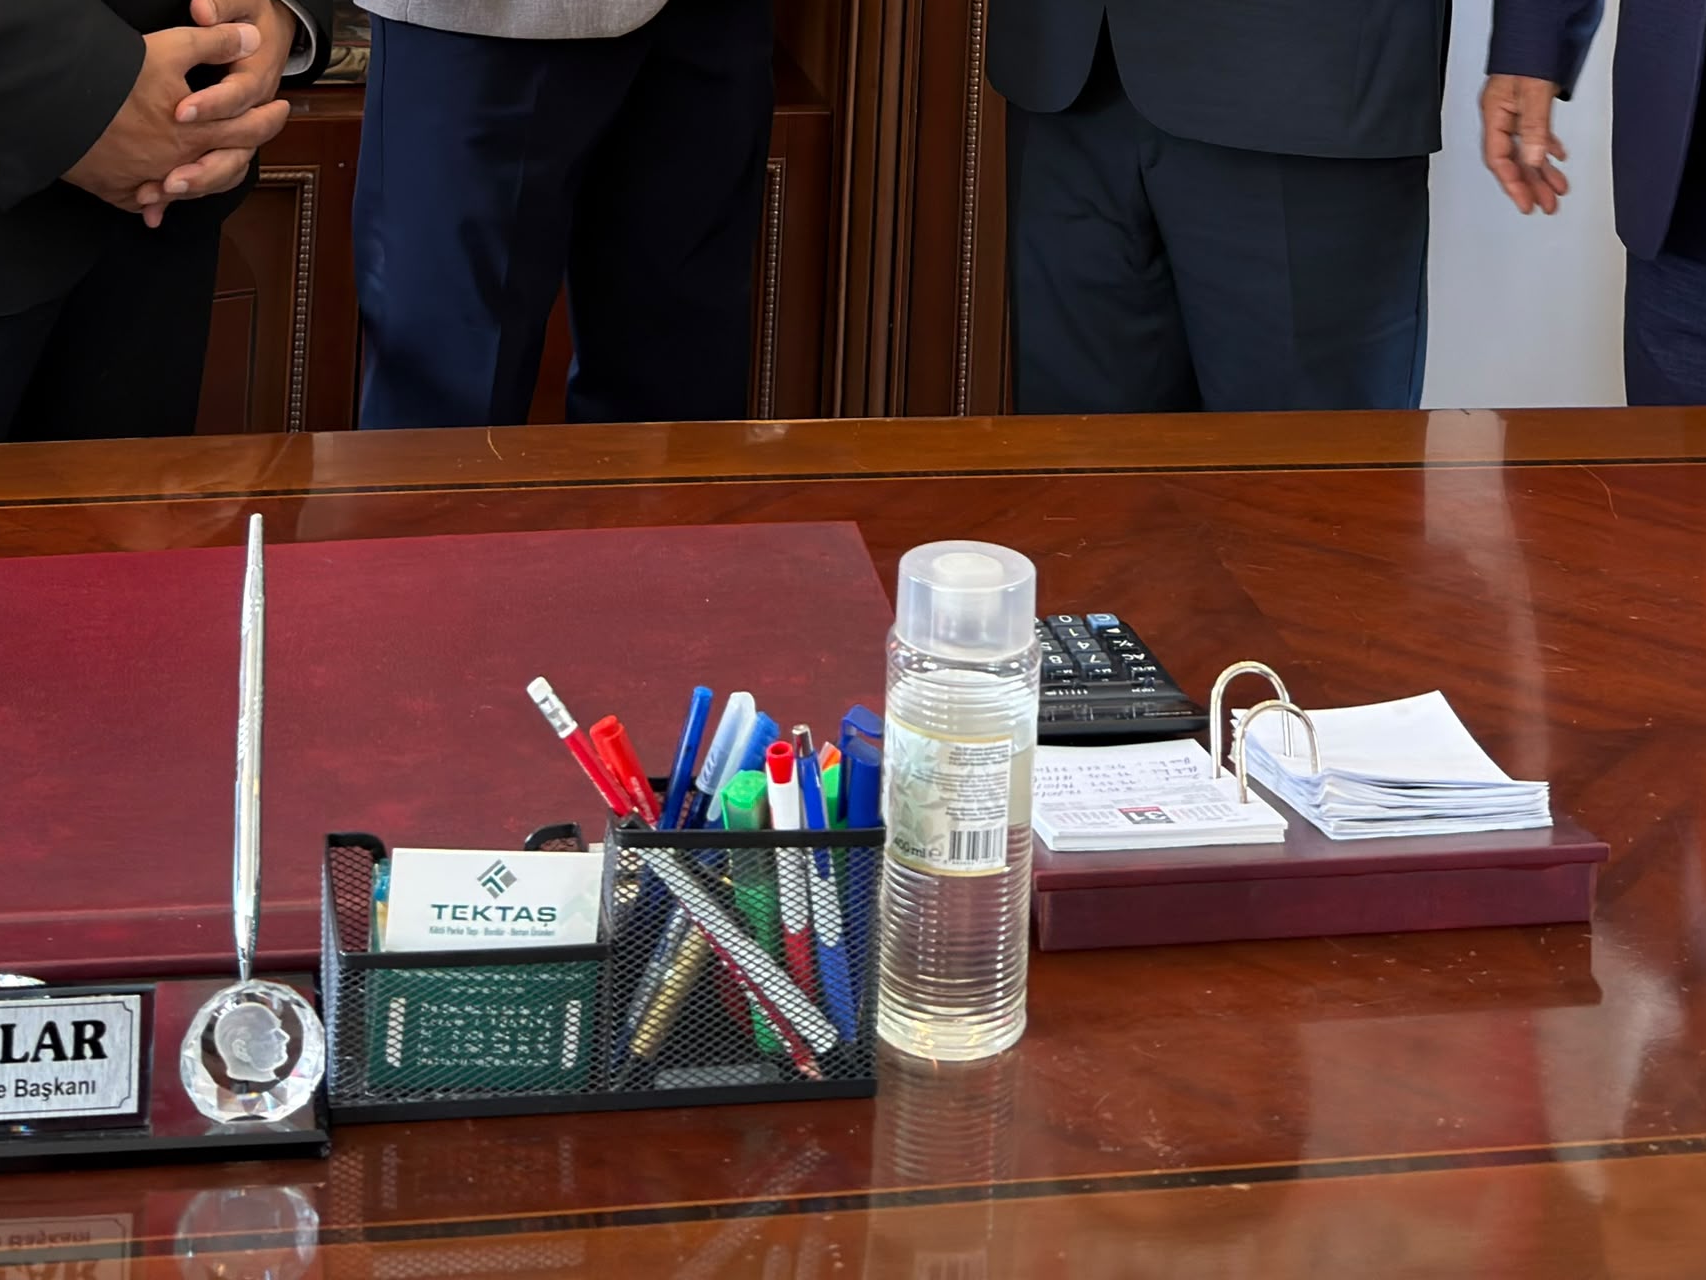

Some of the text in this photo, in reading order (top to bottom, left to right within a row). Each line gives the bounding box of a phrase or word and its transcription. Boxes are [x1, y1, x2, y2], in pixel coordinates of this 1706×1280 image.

[1058, 615, 1073, 623] 0
[1068, 628, 1079, 637] 1
[1077, 641, 1090, 650] 4
[1049, 655, 1063, 664] 8
[1089, 655, 1101, 663] 7
[1128, 811, 1166, 821] 31
[430, 904, 557, 927] TEKTAŞ
[13, 1078, 96, 1102] Başkanı
